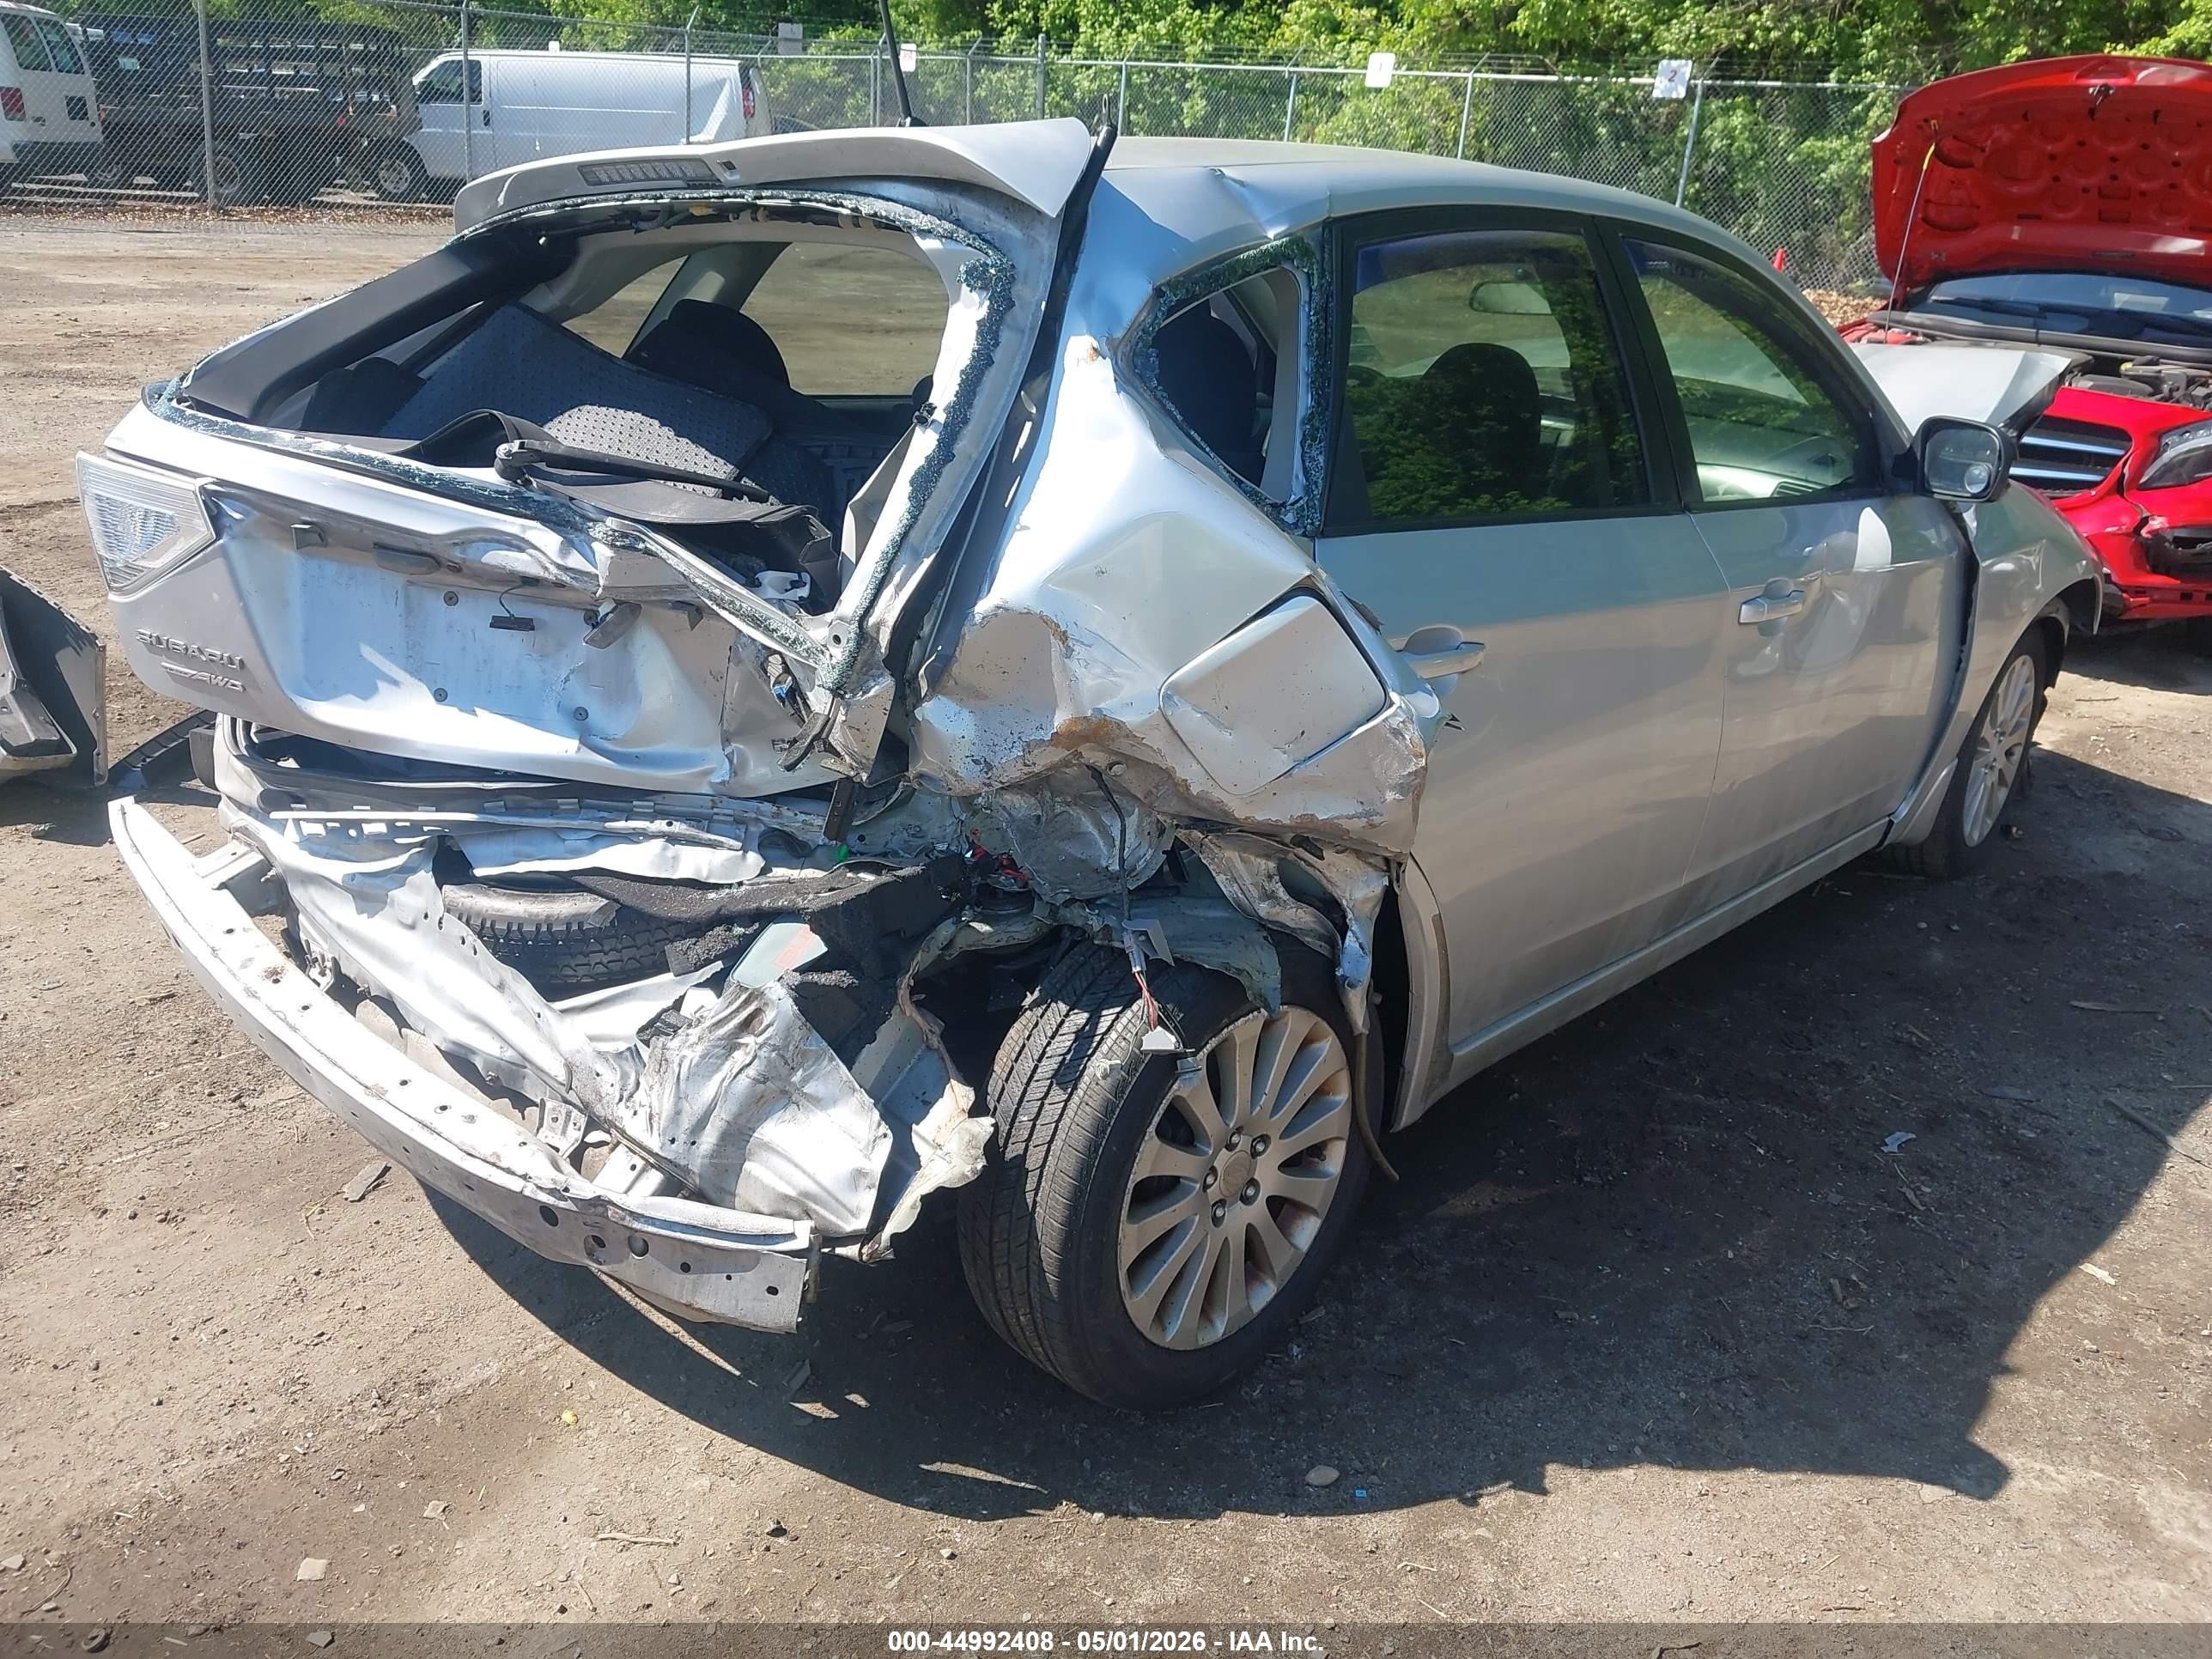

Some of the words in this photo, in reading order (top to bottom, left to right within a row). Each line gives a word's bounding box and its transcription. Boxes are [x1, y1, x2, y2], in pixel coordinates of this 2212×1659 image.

[1668, 69, 1677, 82] 2
[136, 629, 246, 671] SUBARU
[190, 672, 246, 693] AWD
